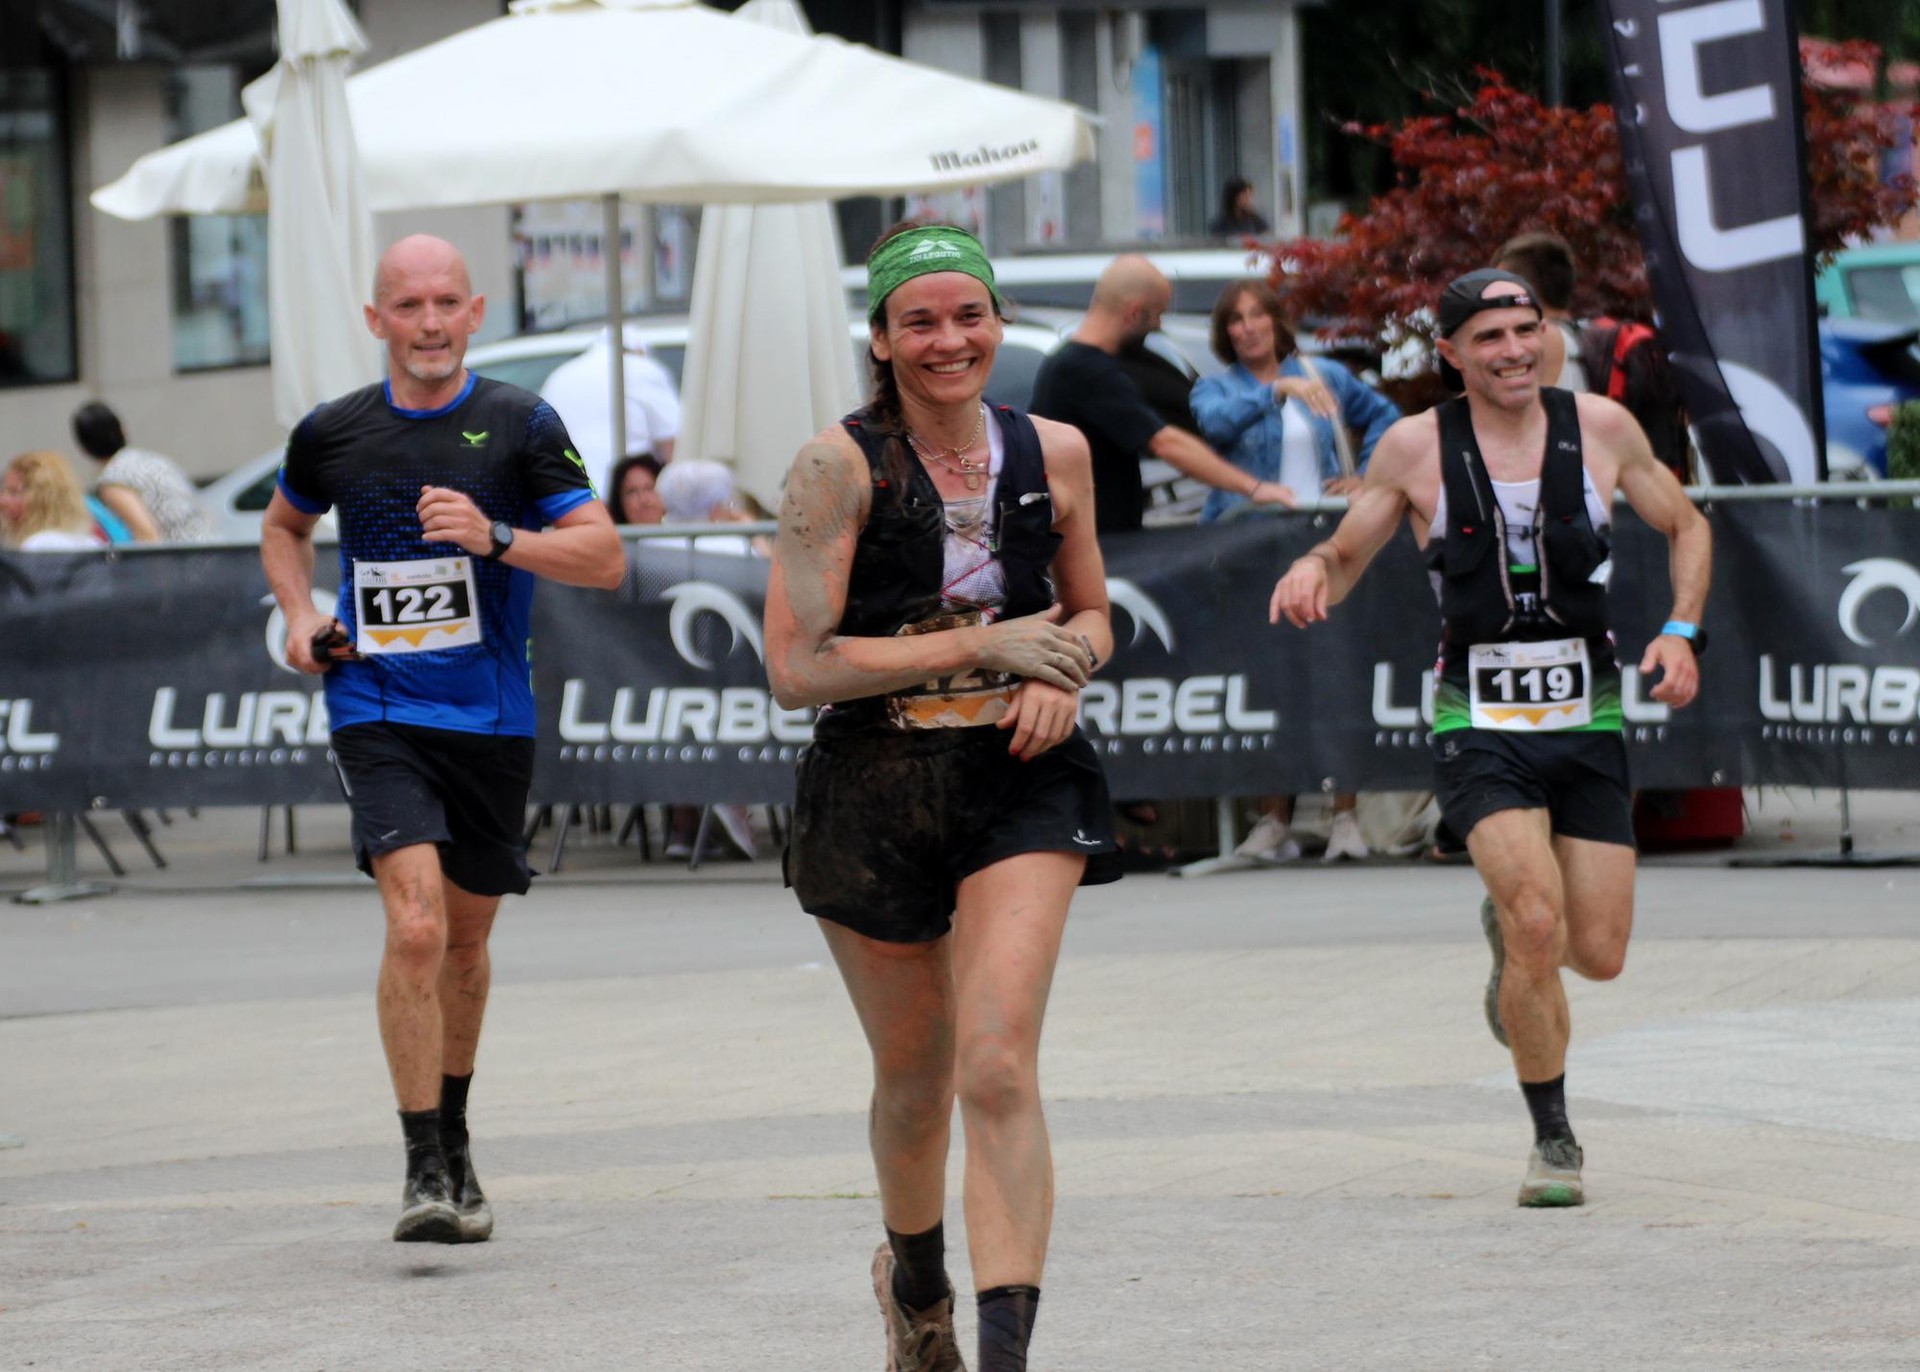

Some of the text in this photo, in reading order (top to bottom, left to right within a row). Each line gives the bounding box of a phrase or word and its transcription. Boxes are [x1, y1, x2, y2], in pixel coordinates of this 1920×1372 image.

[928, 139, 1038, 173] Mahou
[372, 585, 456, 623] 122
[1491, 666, 1574, 702] 119
[1759, 653, 1920, 724] LURB
[1143, 734, 1276, 754] GARMENT
[1761, 724, 1872, 745] PRECISION
[149, 750, 307, 768] PRECISION
[560, 745, 721, 762] PRECISION
